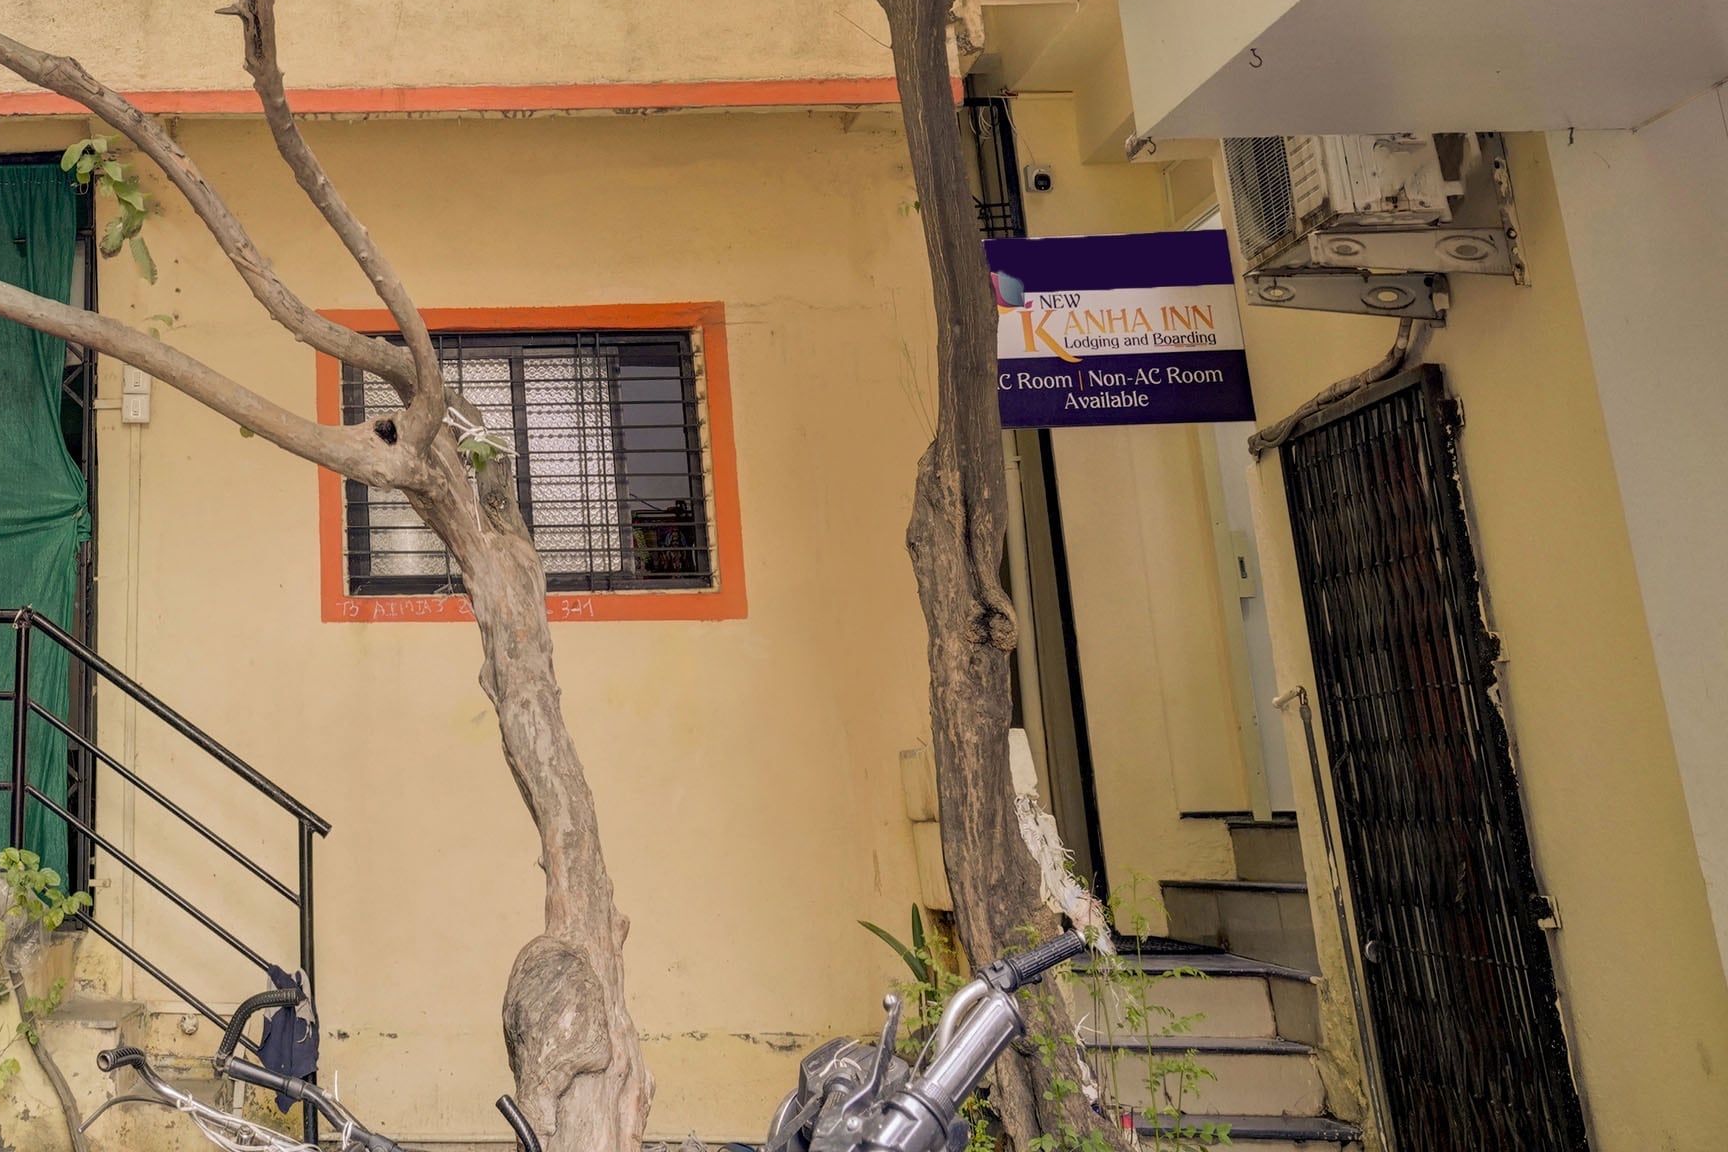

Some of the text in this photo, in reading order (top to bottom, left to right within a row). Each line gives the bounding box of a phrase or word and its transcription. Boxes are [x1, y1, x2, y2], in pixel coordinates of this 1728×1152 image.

[1039, 293, 1081, 309] NEW
[1017, 304, 1215, 363] KANHA INN
[1064, 332, 1217, 350] Lodging and Boarding
[997, 366, 1223, 391] C Room Non-AC Room
[1064, 390, 1150, 410] Available
